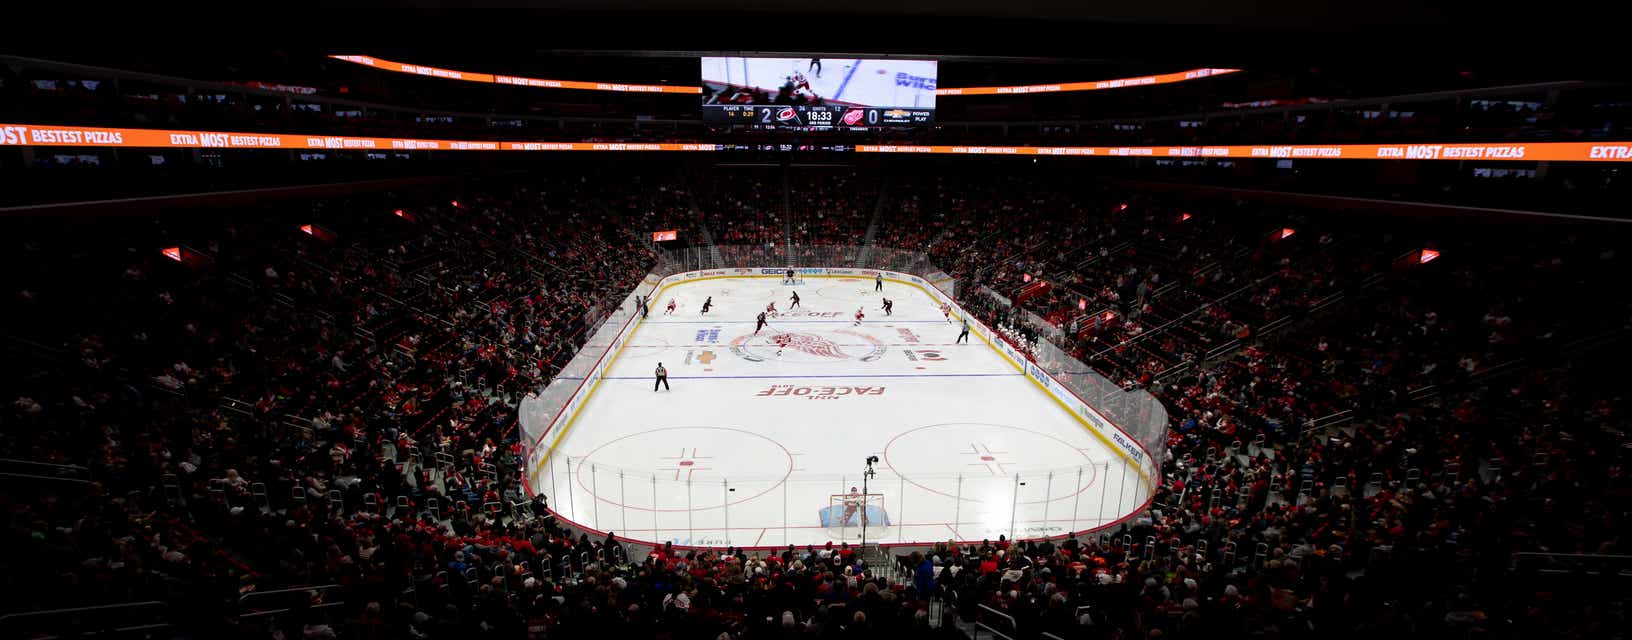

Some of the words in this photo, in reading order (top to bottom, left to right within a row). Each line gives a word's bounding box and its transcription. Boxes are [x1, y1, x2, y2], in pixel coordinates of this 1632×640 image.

[762, 108, 771, 123] 2
[806, 111, 832, 121] 18:33
[868, 109, 878, 124] 0
[31, 129, 82, 143] BESTEST
[84, 131, 122, 144] PIZZAS
[170, 134, 199, 145] EXTRA
[199, 133, 229, 147] MOST
[1269, 146, 1293, 157] MOST
[1377, 148, 1404, 157] EXTRA
[1405, 146, 1442, 159] MOST
[1443, 148, 1484, 158] BESTEST
[1485, 147, 1526, 158] PIZZAS
